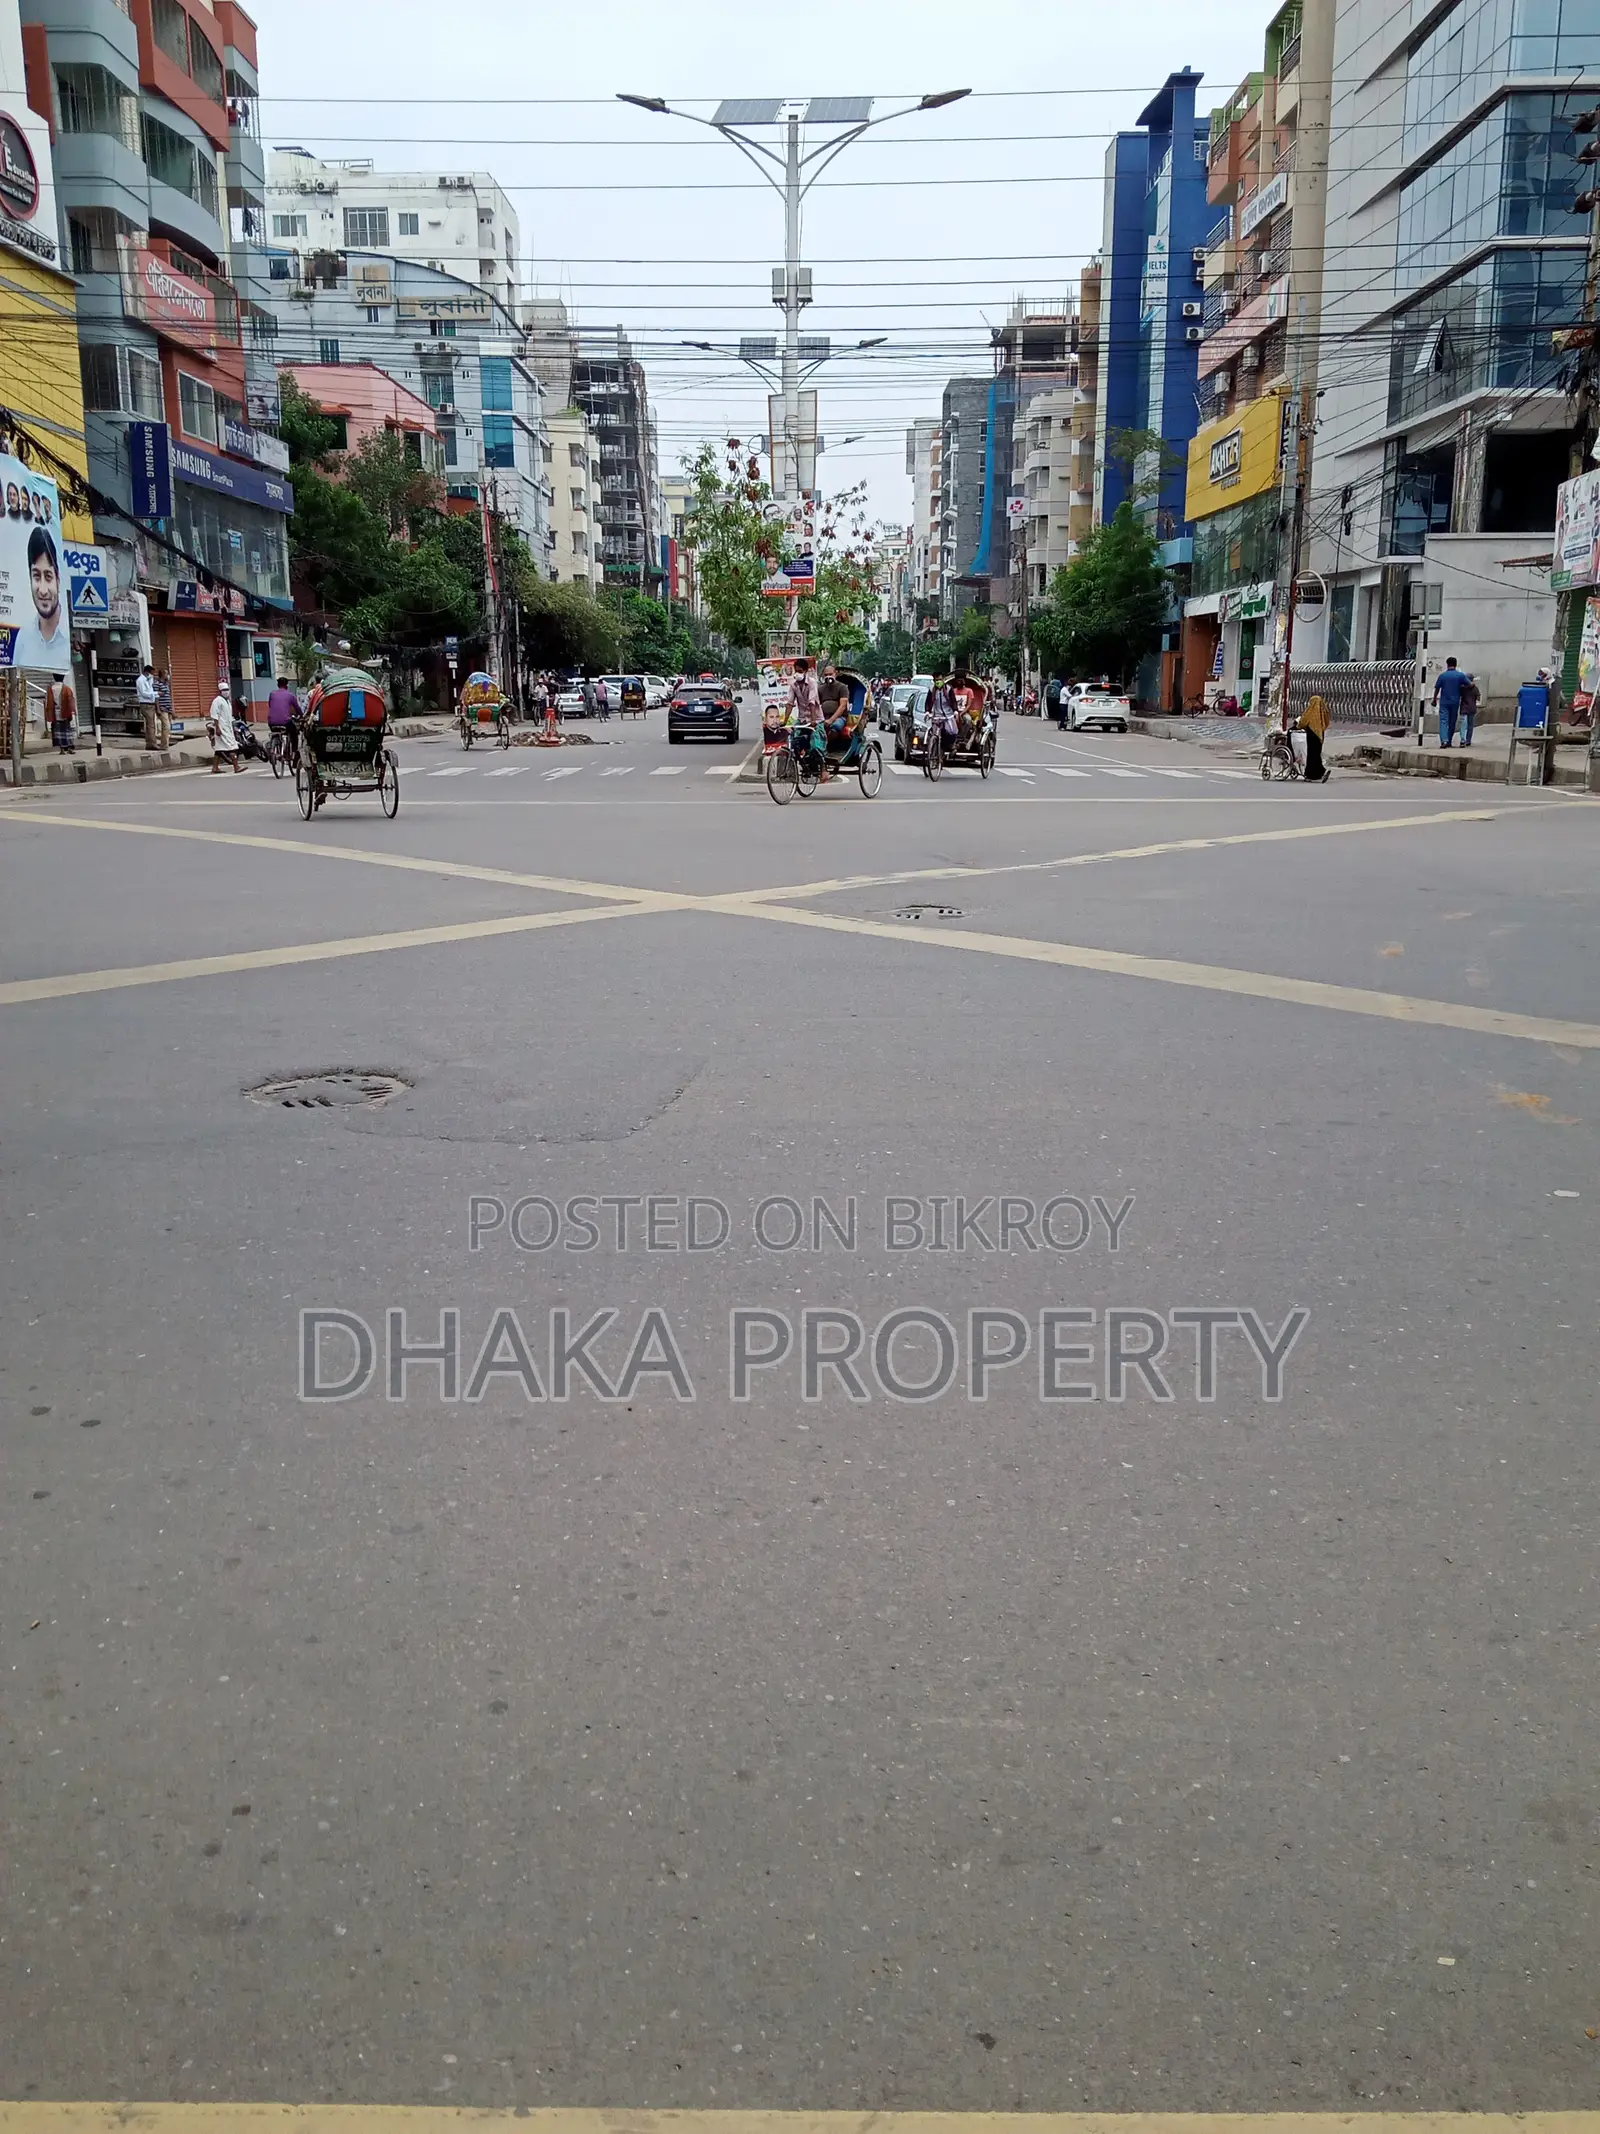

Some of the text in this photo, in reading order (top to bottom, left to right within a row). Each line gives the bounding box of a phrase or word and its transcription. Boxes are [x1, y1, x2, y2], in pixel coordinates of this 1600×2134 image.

[1148, 261, 1167, 270] IELTS
[144, 426, 155, 478] SAMSUNG
[170, 446, 211, 481] SAMSUNG
